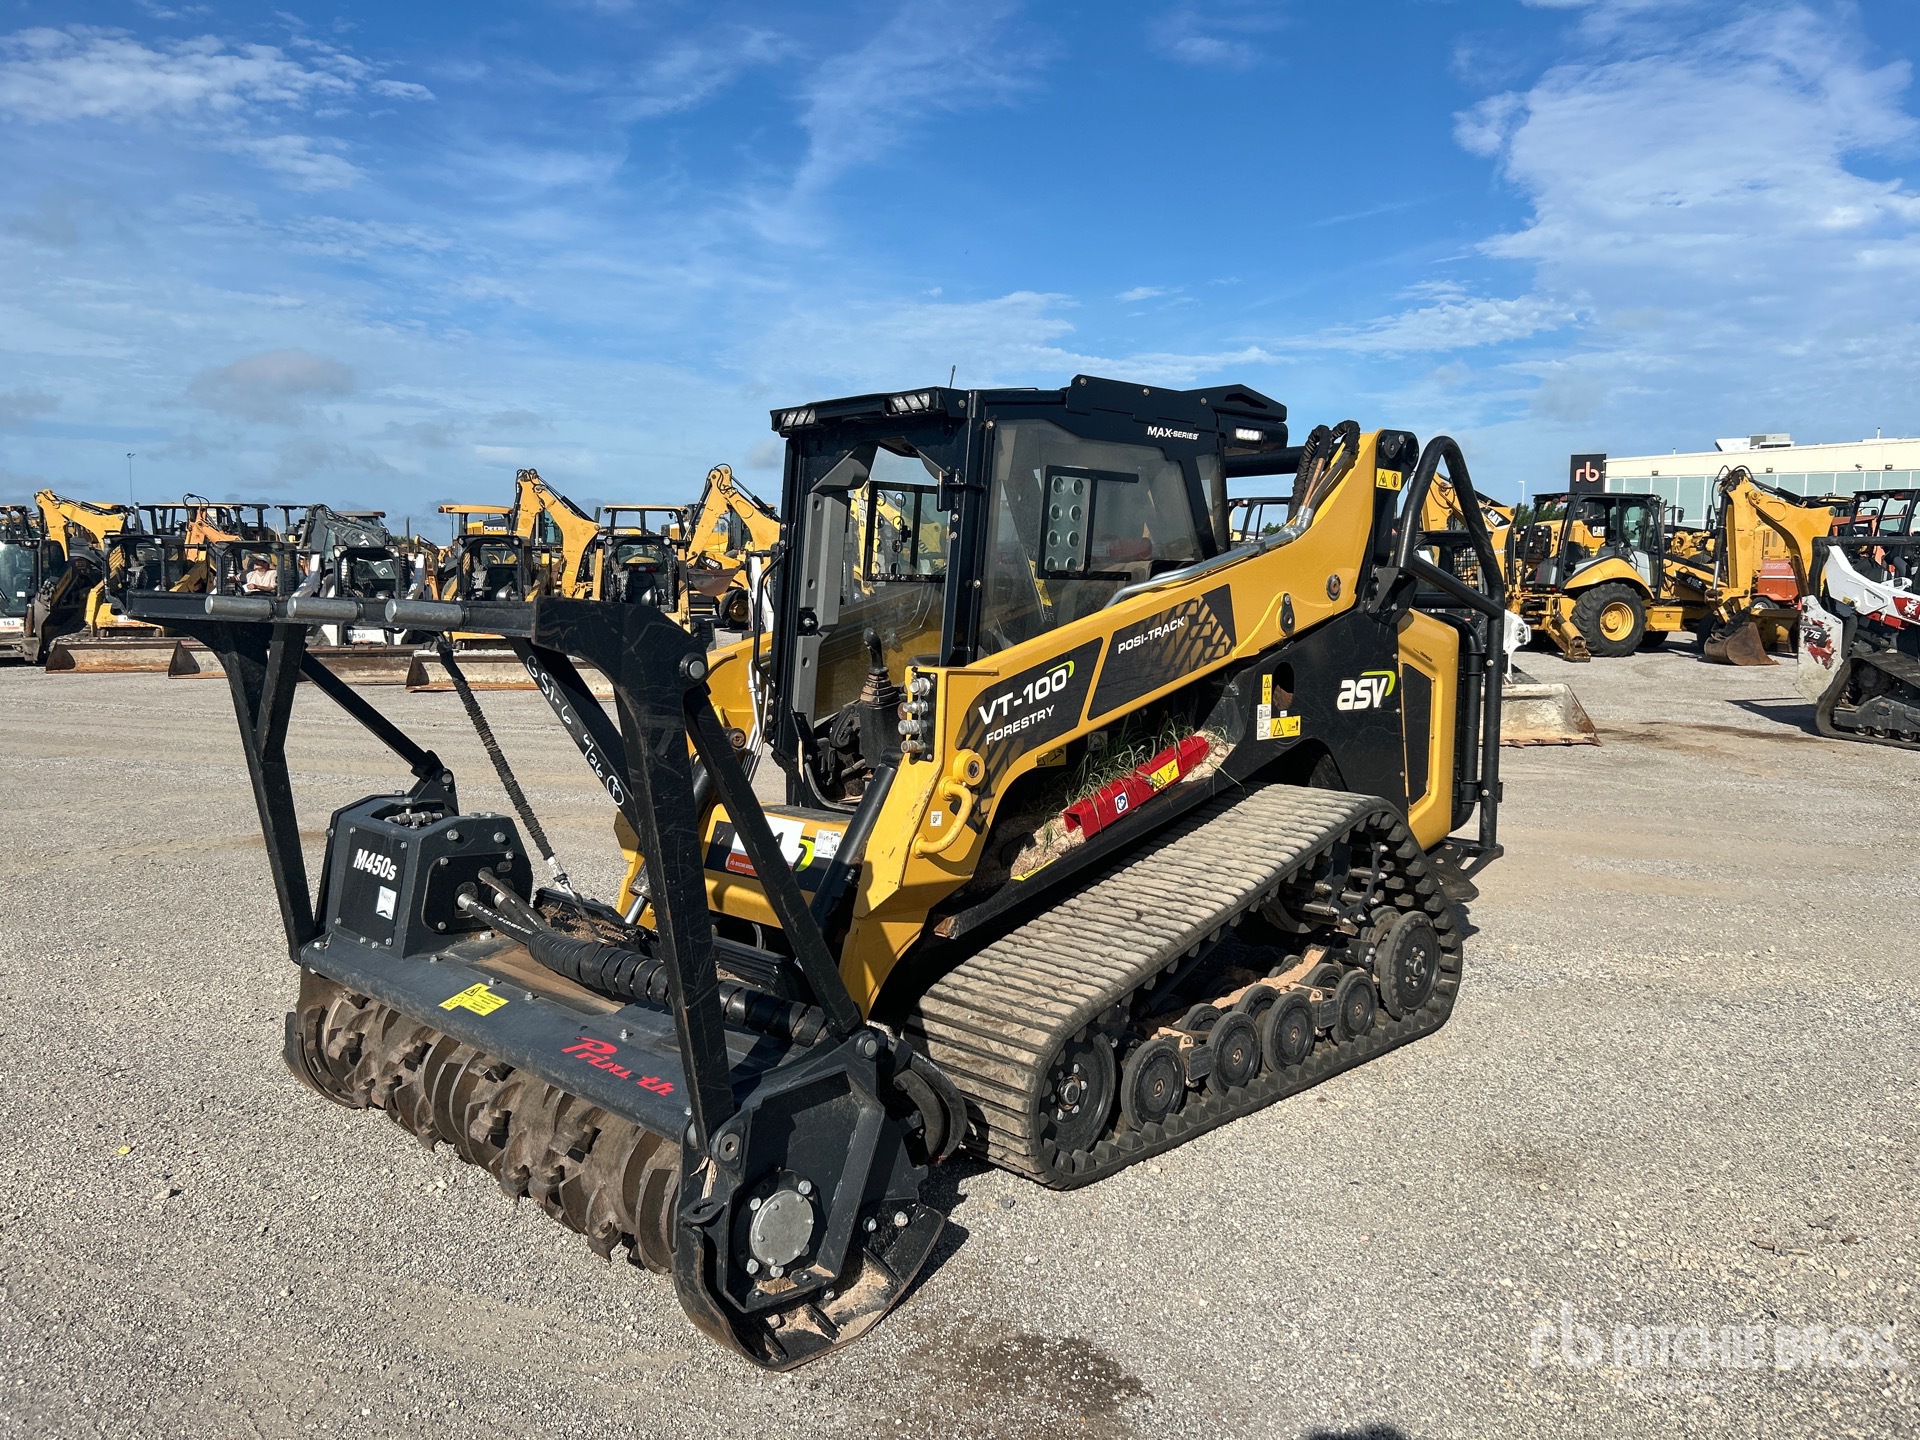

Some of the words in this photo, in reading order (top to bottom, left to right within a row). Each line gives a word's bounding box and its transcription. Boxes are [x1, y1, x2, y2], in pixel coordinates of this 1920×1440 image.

[1147, 425, 1200, 441] MAX-SERIES
[1575, 461, 1600, 482] rb
[1487, 509, 1504, 526] CAT
[1592, 526, 1606, 537] CAT
[1117, 615, 1186, 655] POSI-TRACK
[978, 668, 1067, 726] VT-100
[986, 704, 1055, 746] FORESTRY
[352, 848, 398, 881] M450s
